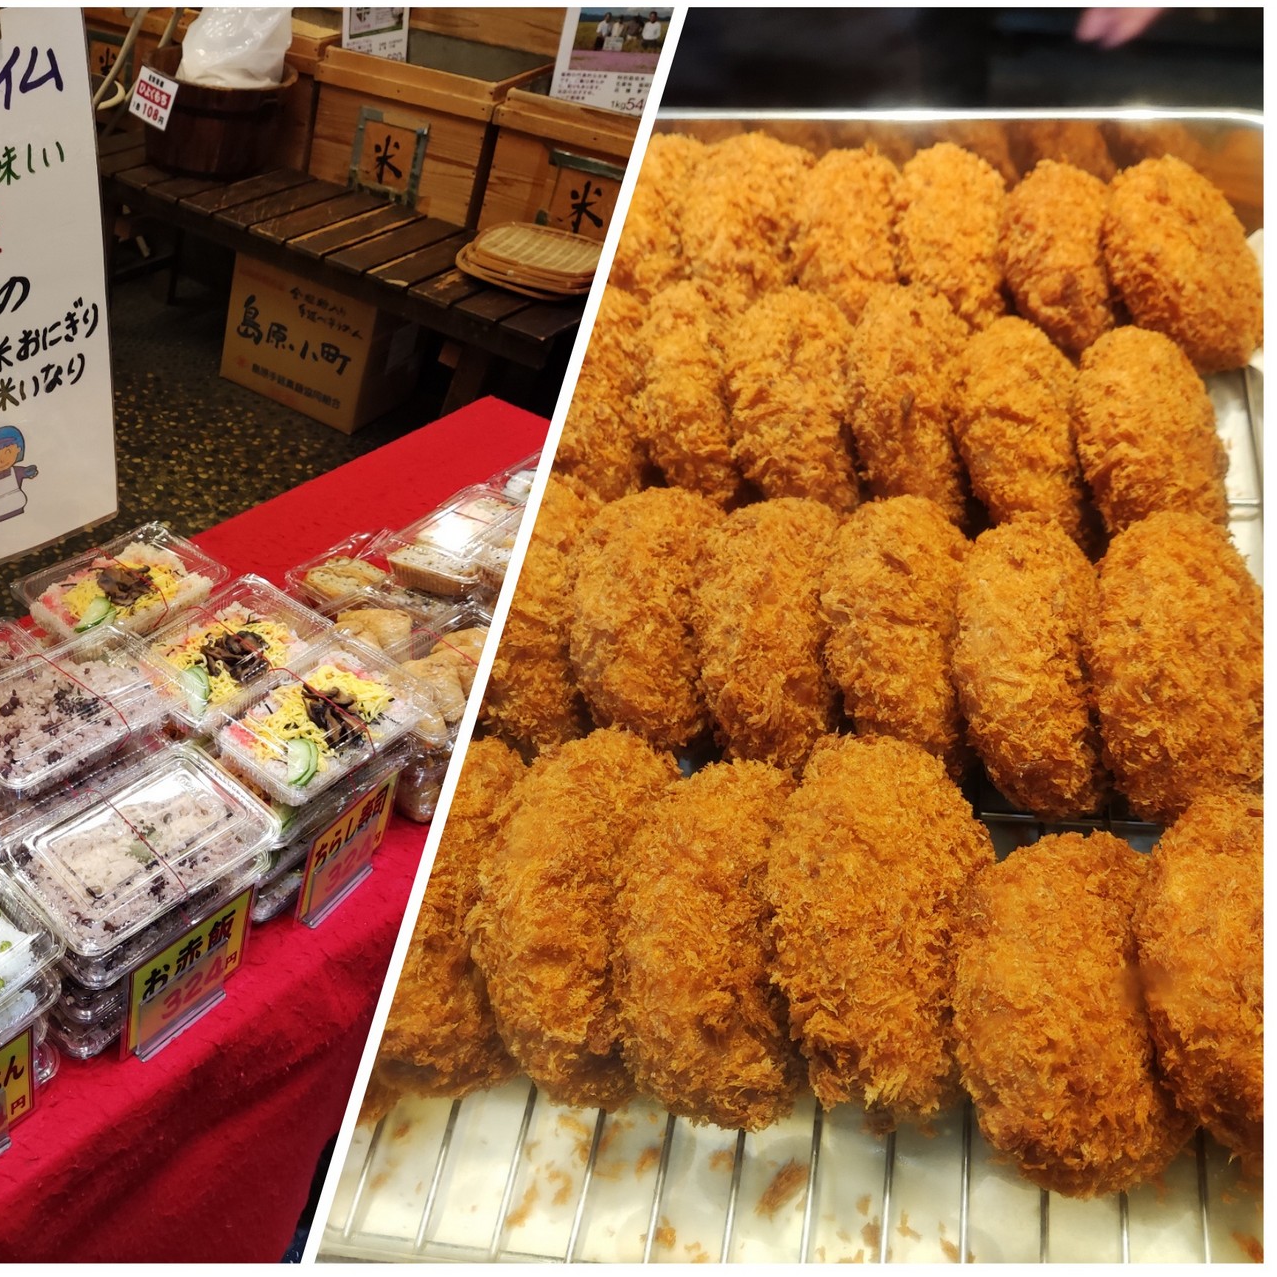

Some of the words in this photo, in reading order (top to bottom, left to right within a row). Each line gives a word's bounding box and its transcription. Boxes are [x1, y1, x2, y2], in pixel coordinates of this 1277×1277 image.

[375, 134, 403, 185] 米
[570, 180, 604, 234] 米
[236, 294, 352, 376] 島原小町
[142, 909, 237, 1003] お赤飯
